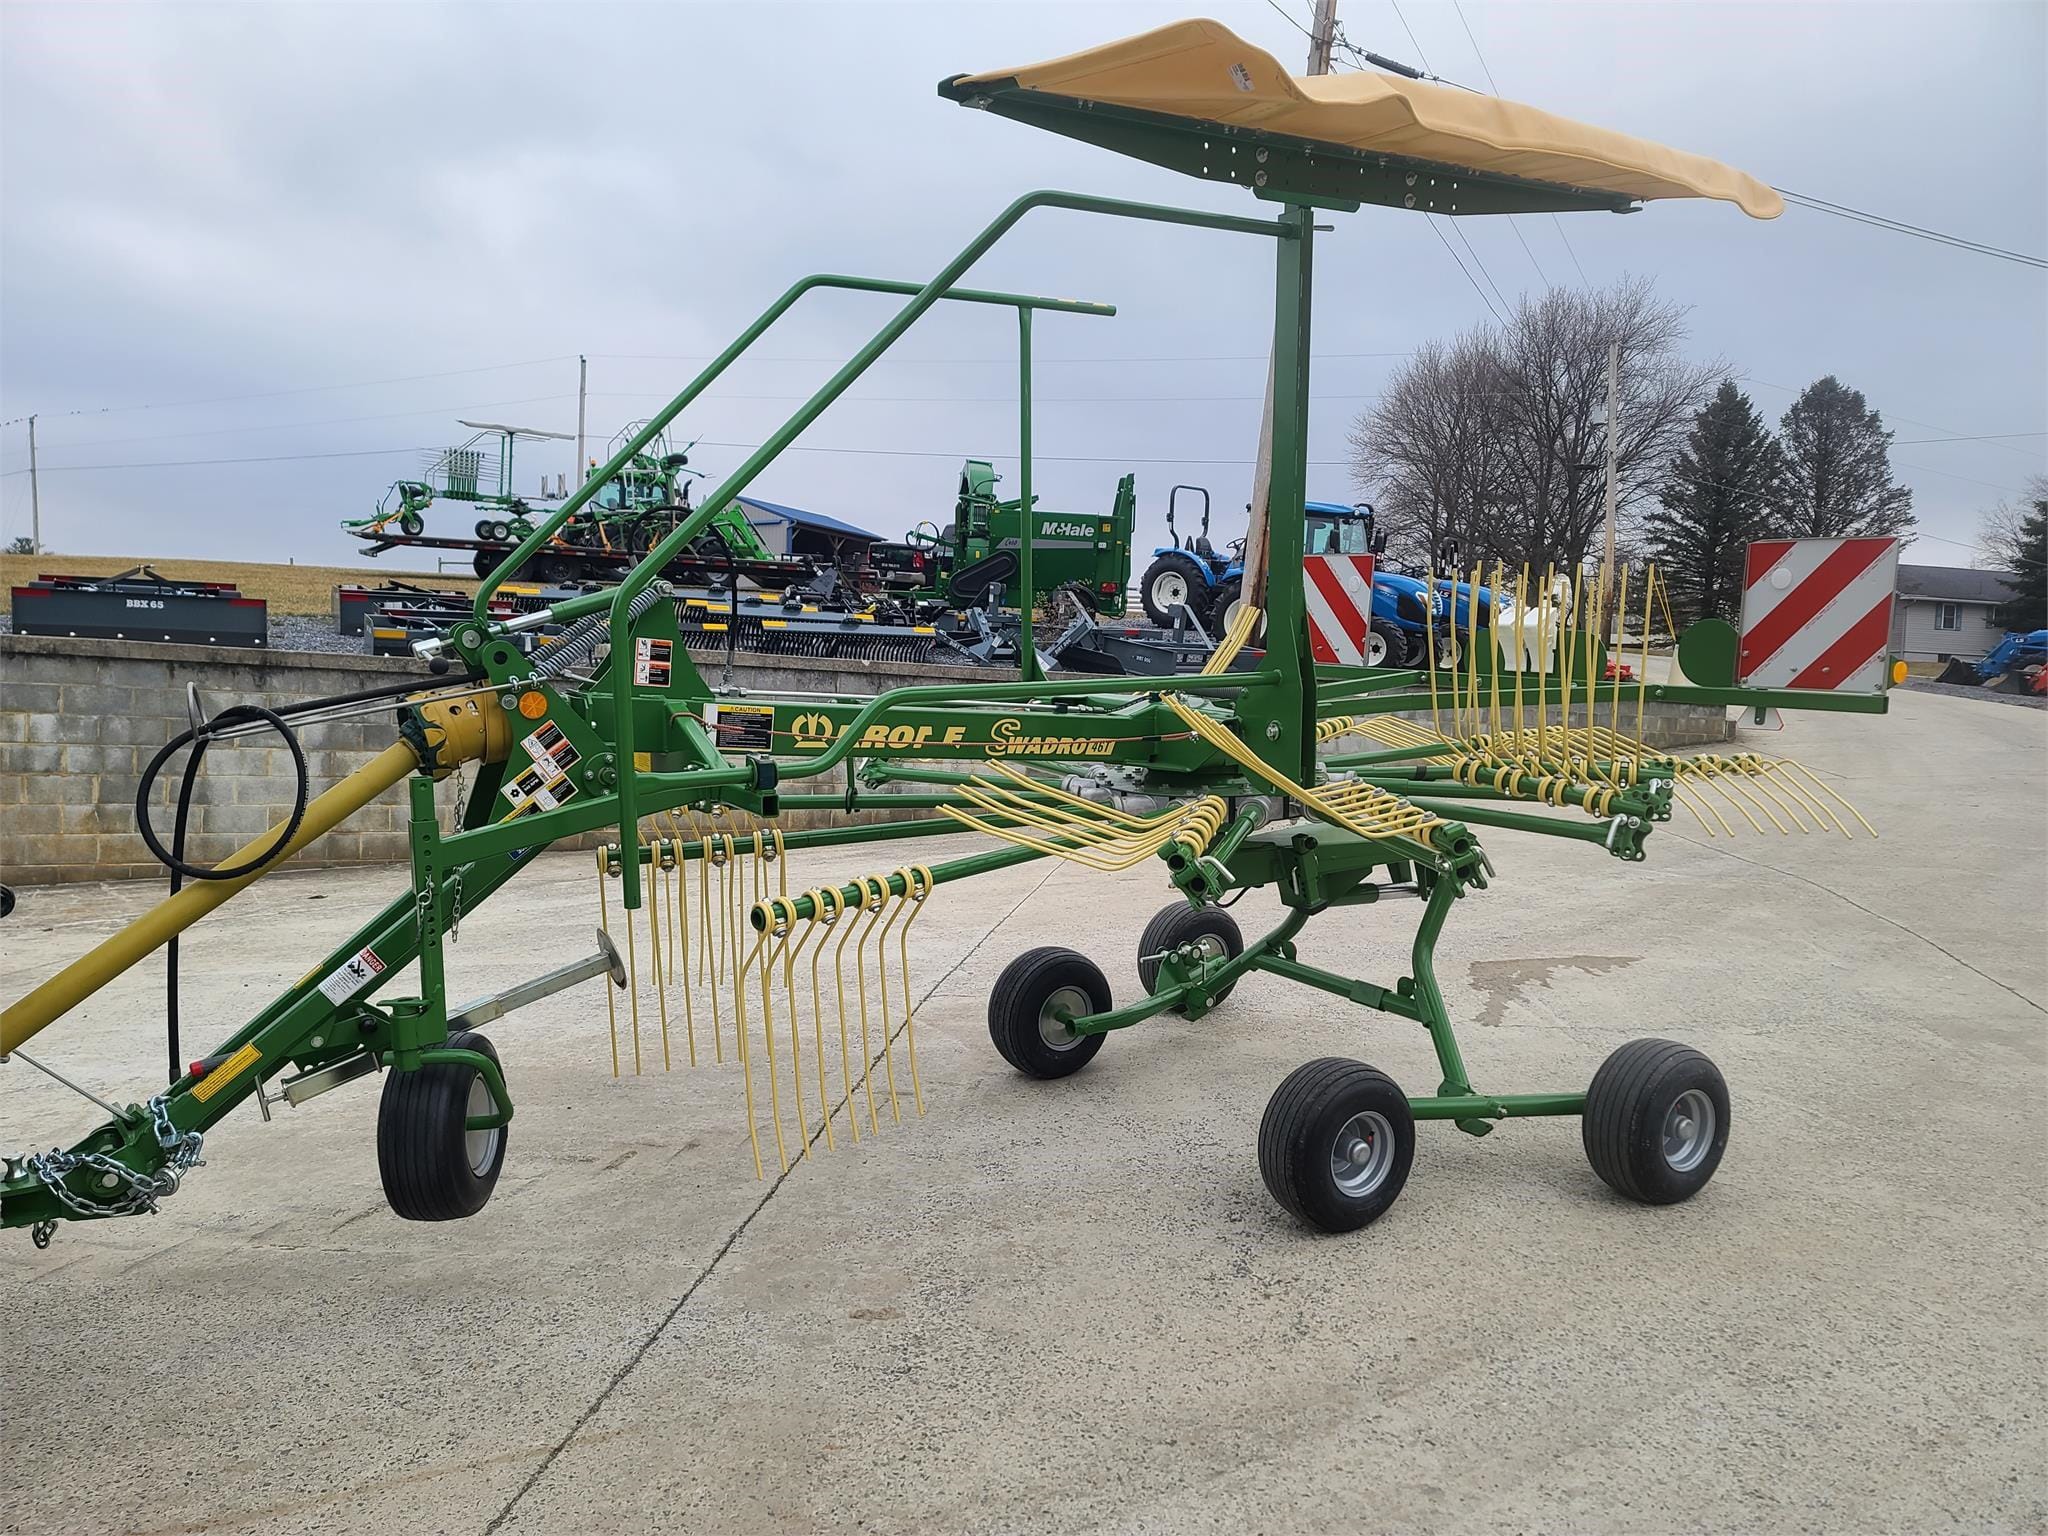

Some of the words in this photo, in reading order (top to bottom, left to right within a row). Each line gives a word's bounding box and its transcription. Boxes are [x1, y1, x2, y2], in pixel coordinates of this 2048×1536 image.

[1041, 522, 1095, 537] McHale
[126, 599, 149, 608] BBX
[150, 600, 164, 608] 65
[985, 719, 1088, 756] SWADRO
